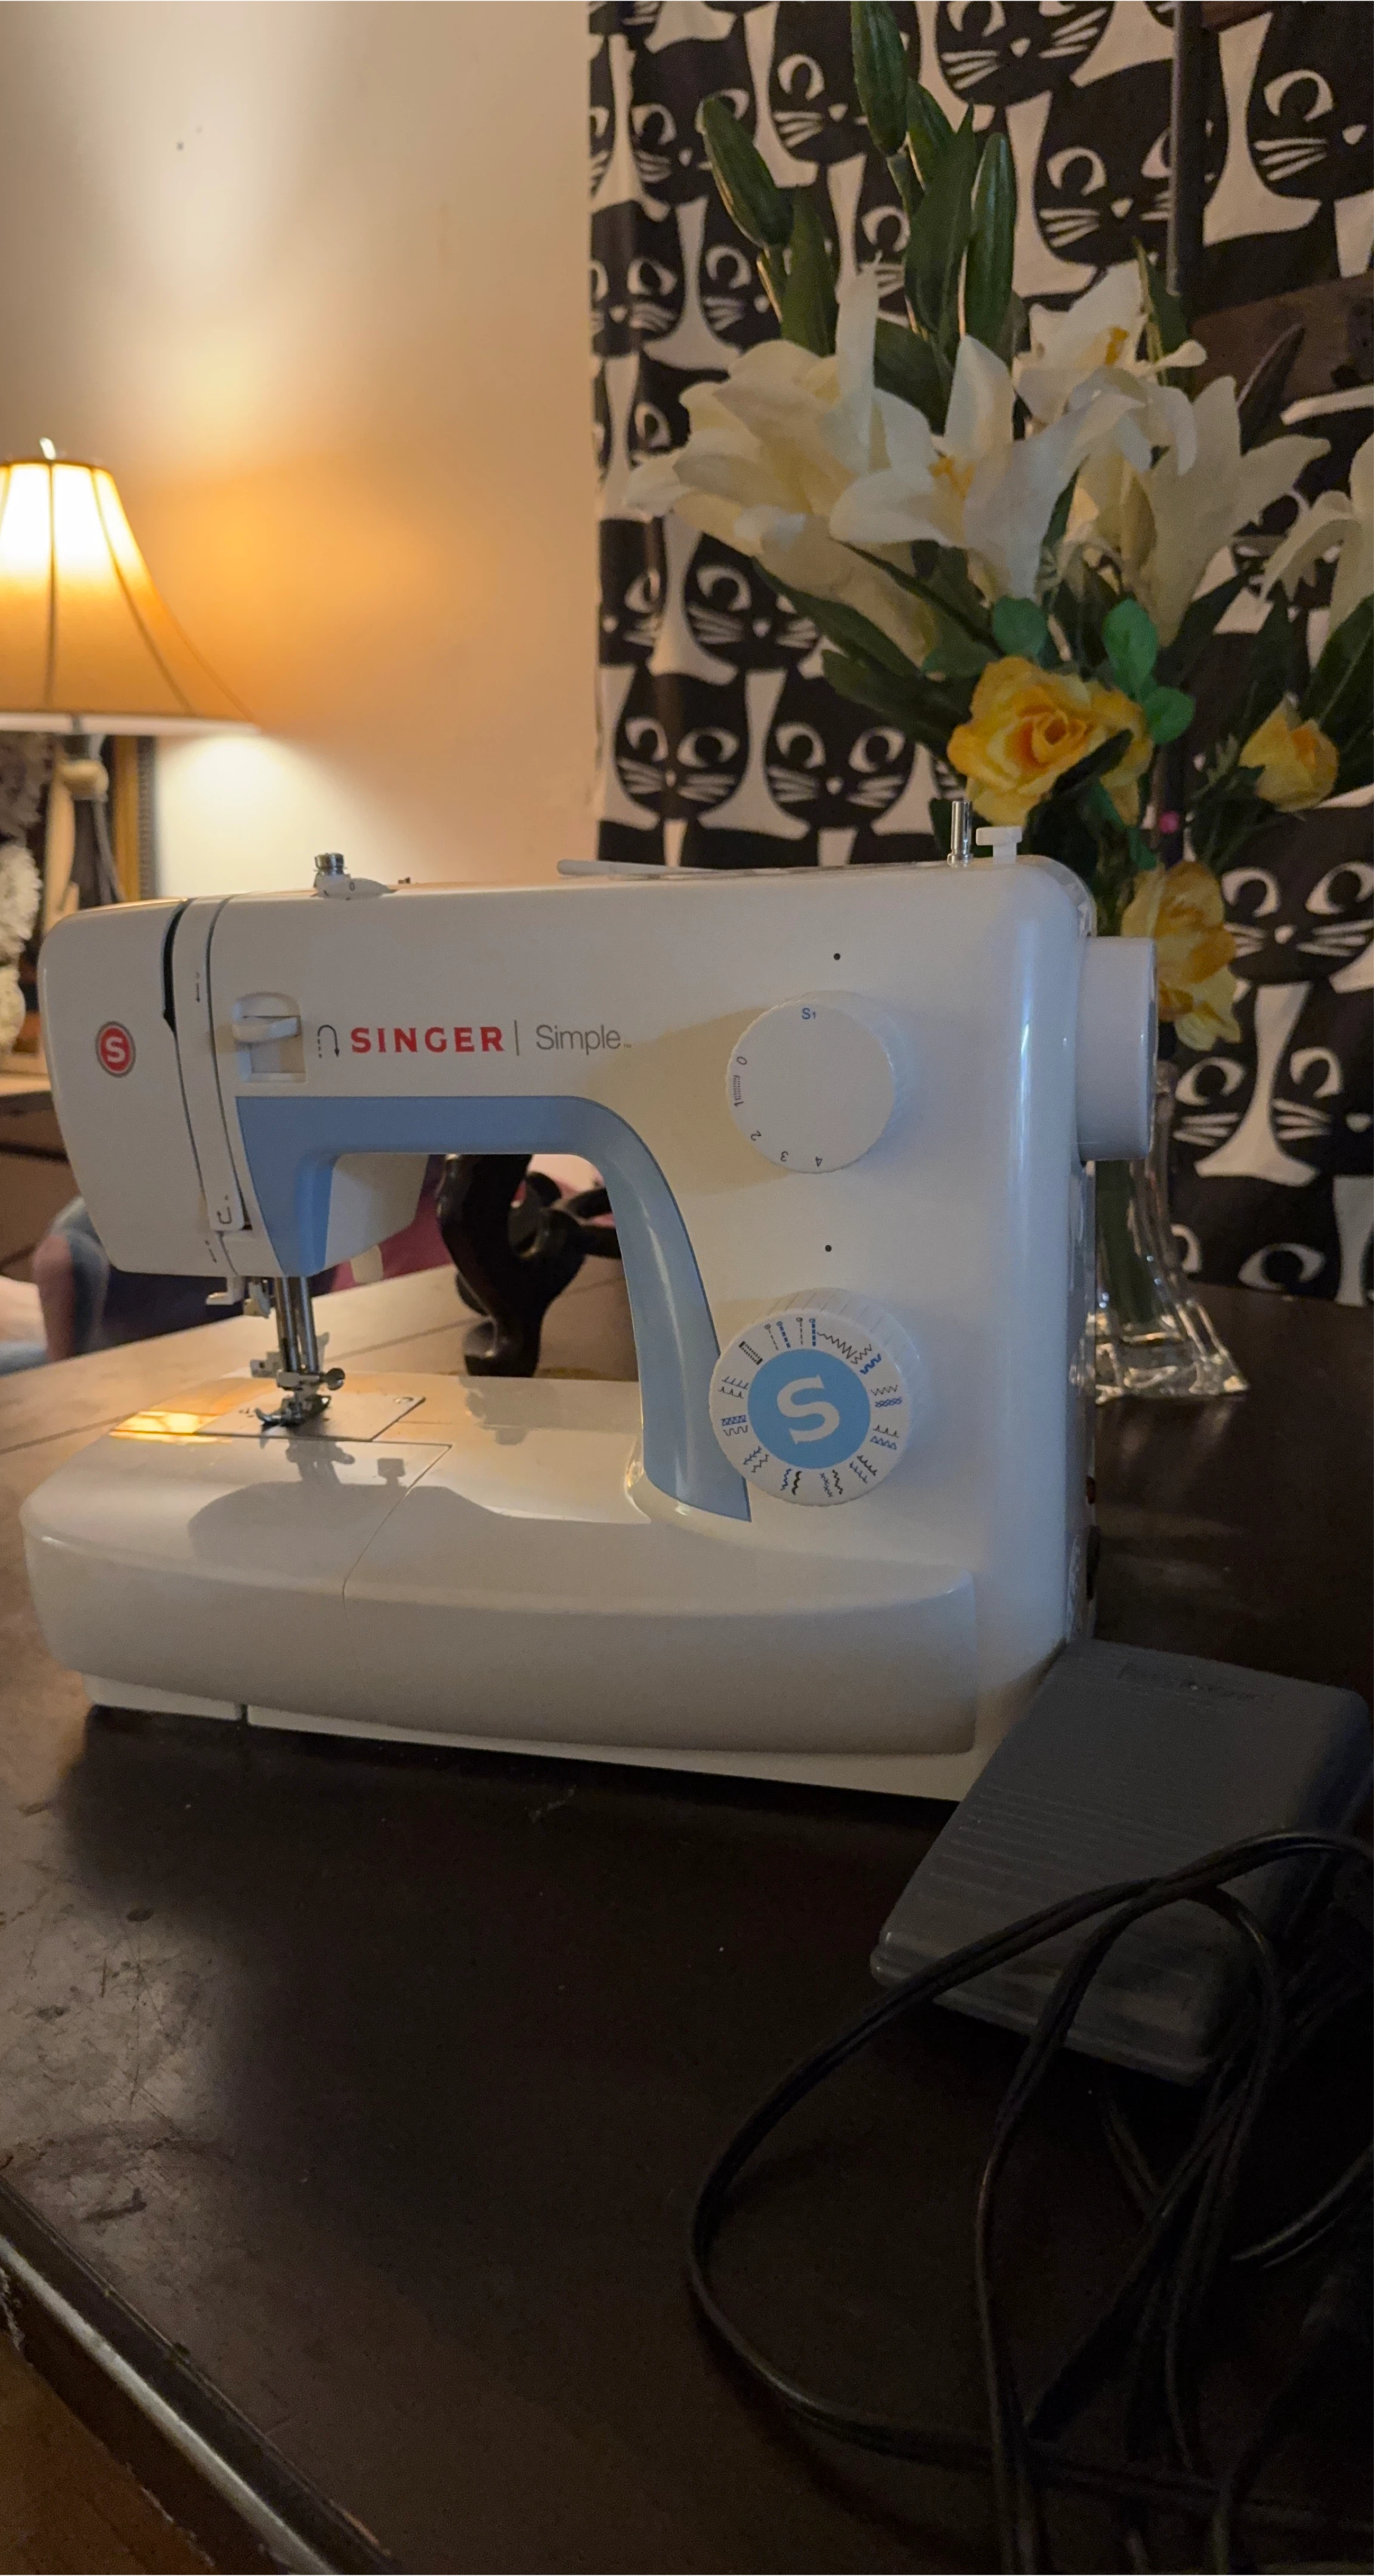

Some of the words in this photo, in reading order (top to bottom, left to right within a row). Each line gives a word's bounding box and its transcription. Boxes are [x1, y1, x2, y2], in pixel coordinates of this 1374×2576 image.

[350, 1026, 505, 1054] SINGER
[536, 1023, 621, 1055] Simple
[106, 1036, 126, 1064] S
[750, 1130, 762, 1141] 2
[780, 1151, 789, 1162] 3
[815, 1156, 823, 1168] 4
[776, 1374, 841, 1446] S
